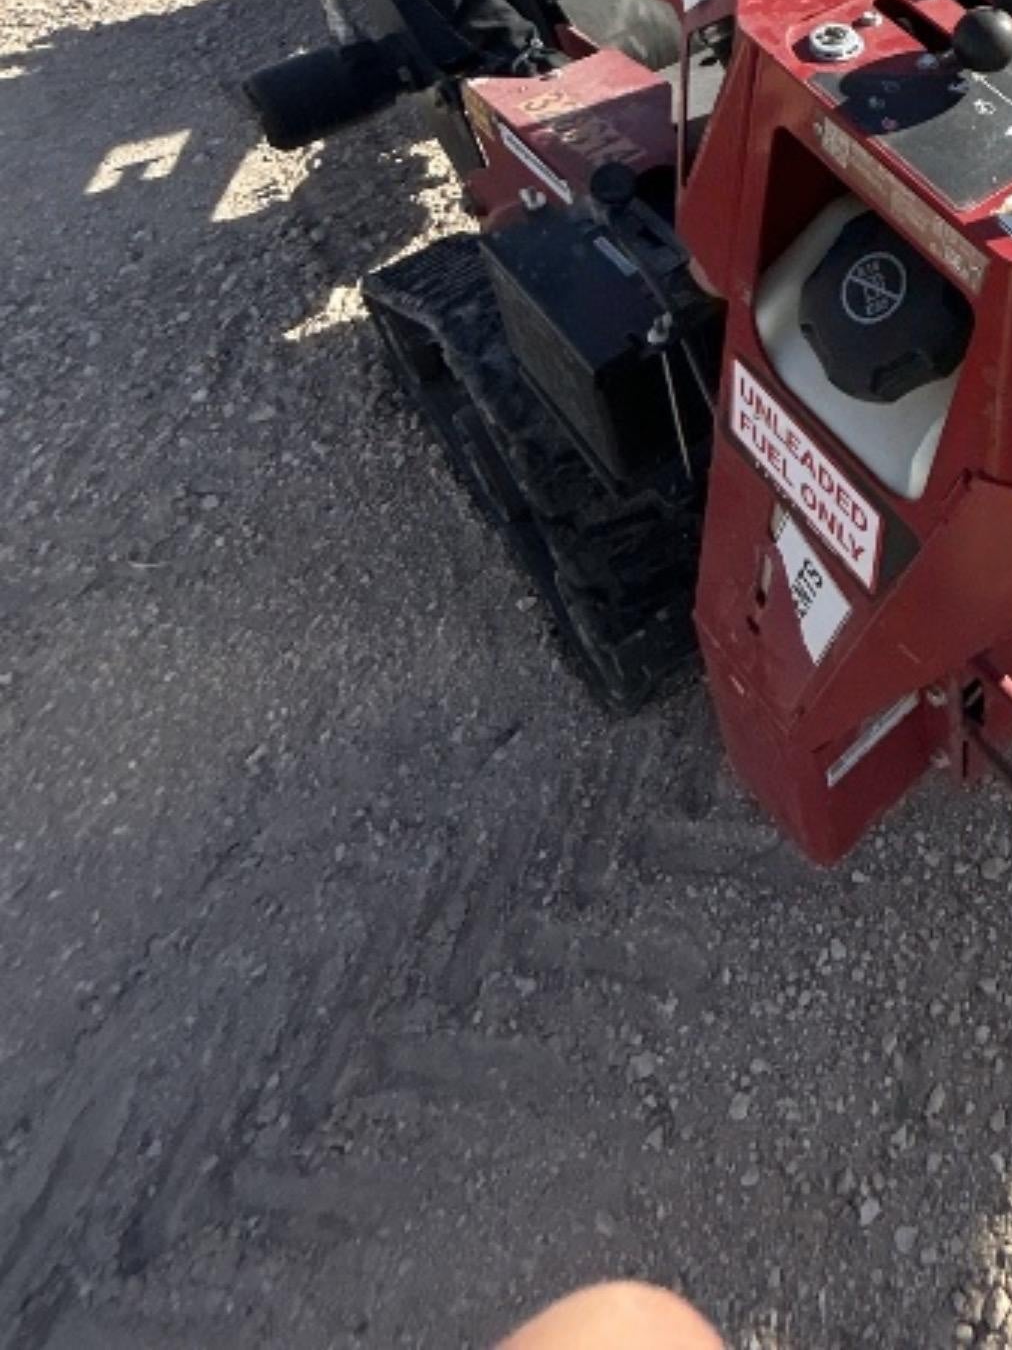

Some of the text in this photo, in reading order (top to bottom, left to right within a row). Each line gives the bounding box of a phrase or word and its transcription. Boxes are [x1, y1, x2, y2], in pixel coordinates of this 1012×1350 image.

[740, 377, 868, 532] UNLEADED
[740, 412, 866, 561] FUEL ONLY
